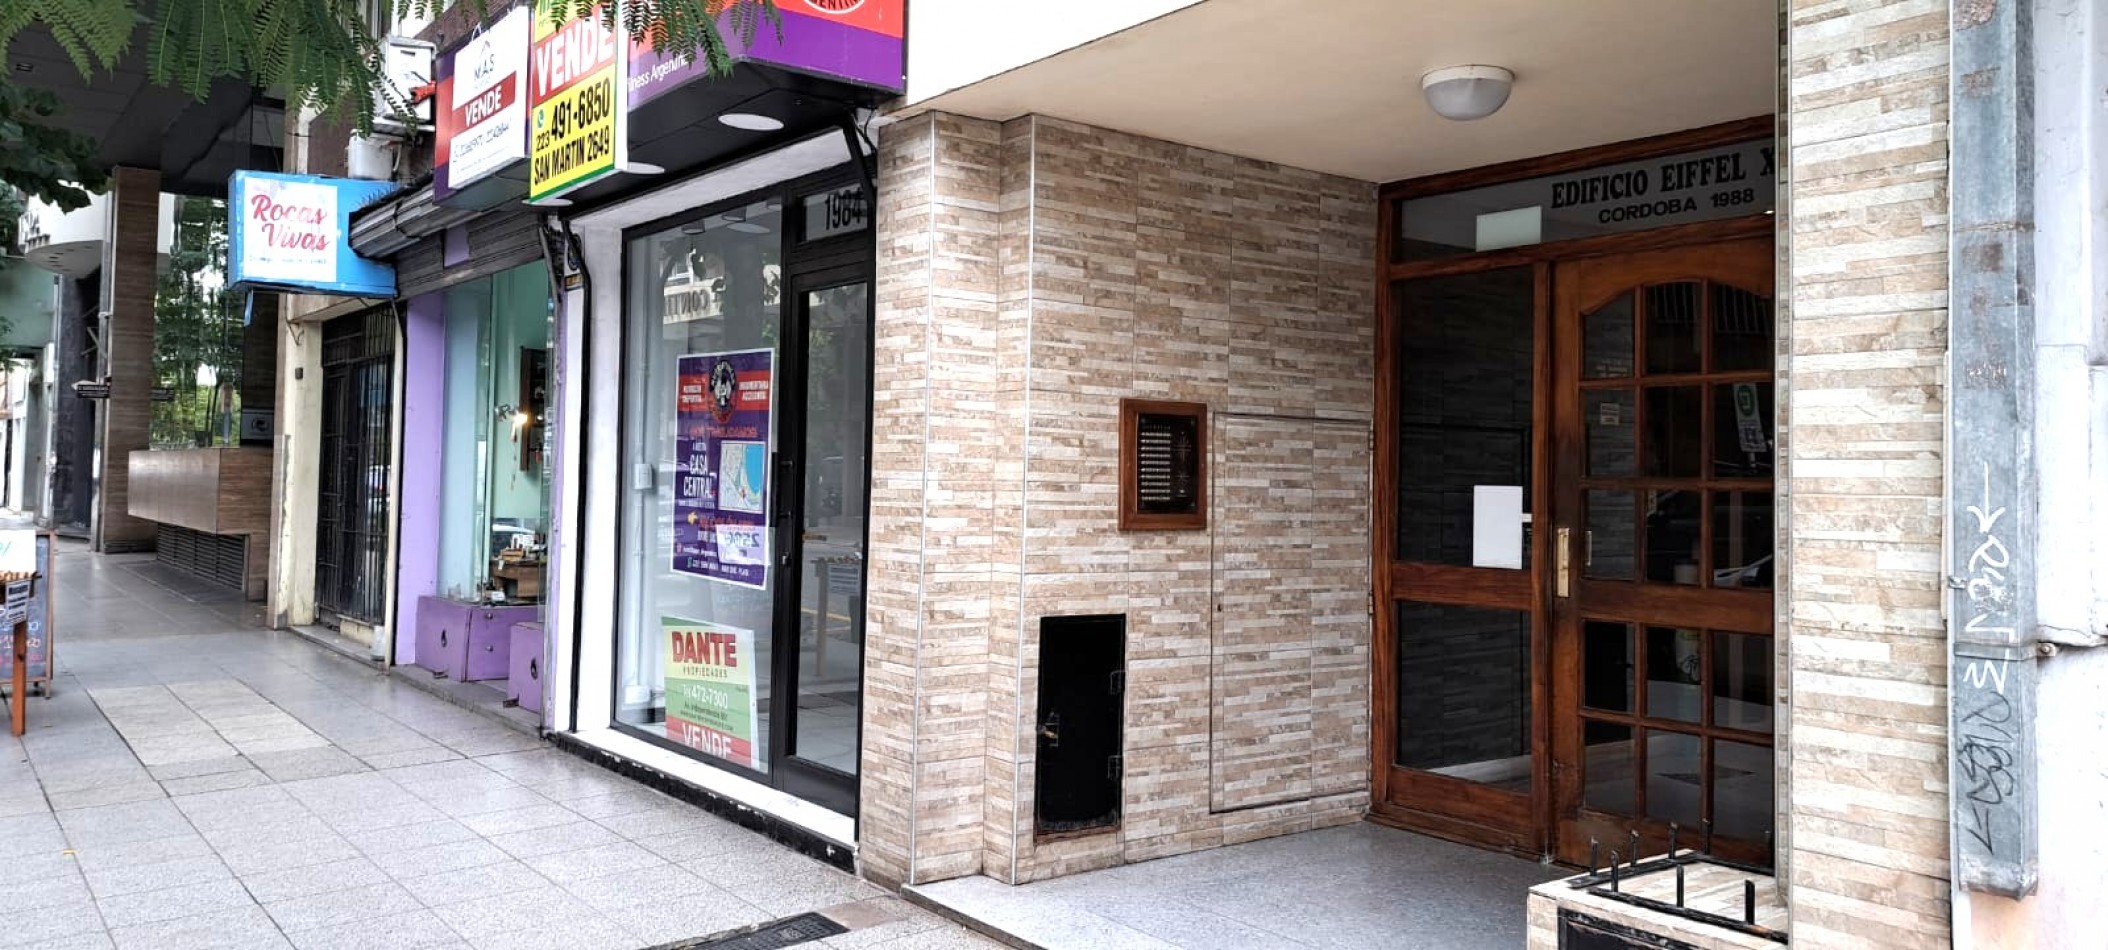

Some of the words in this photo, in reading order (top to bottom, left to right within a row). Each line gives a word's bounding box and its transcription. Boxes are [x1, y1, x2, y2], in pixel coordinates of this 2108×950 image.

[536, 5, 614, 97] VENDE
[465, 85, 502, 127] VENDE
[536, 131, 550, 152] 223
[551, 77, 611, 141] 491-6850
[534, 153, 550, 185] SAN
[552, 136, 585, 175] MARTIN
[587, 125, 610, 162] 2649
[1551, 169, 1648, 208] EDIFICIO
[1660, 153, 1746, 192] EIFFEL
[251, 194, 327, 225] Rocas
[825, 187, 863, 230] 1984
[1599, 197, 1697, 224] CORDOBA
[1711, 188, 1755, 208] 1988
[262, 223, 330, 251] Vivas
[690, 454, 708, 475] CASA
[684, 476, 713, 498] CENTRAL
[671, 631, 737, 668] DANTE
